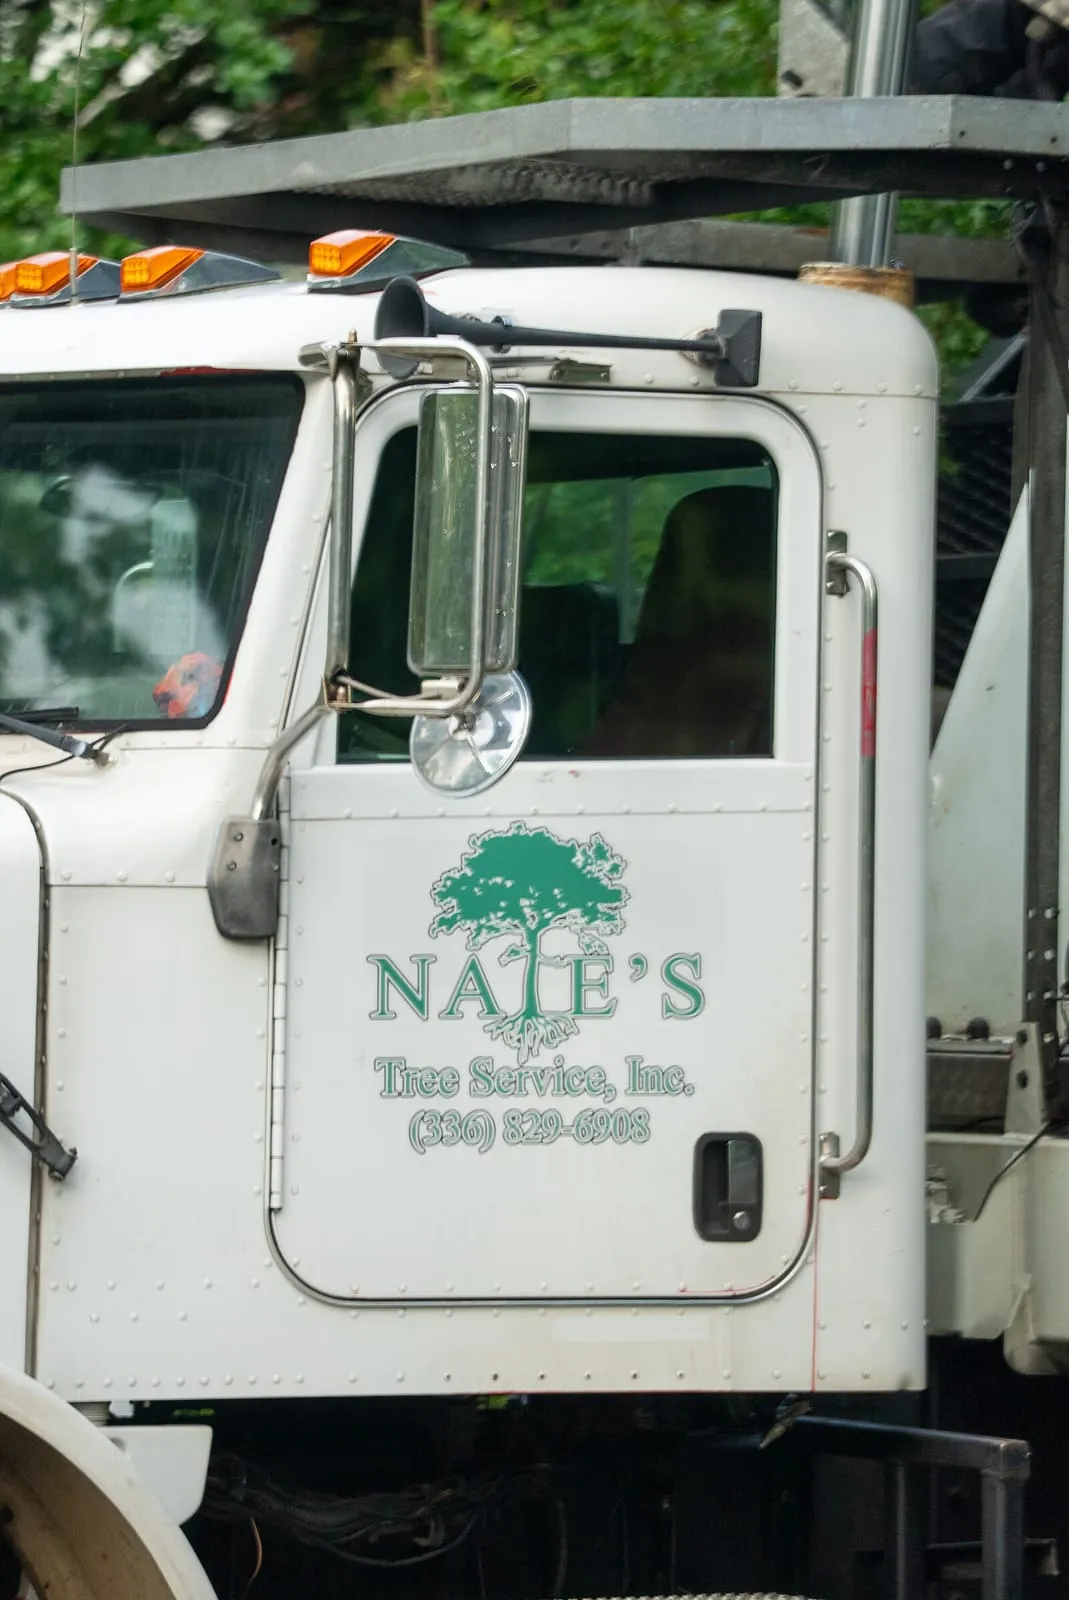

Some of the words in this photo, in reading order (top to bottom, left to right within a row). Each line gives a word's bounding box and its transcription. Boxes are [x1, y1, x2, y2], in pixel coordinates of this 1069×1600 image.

[374, 1056, 460, 1099] Tree
[469, 1055, 616, 1104] Service,
[625, 1055, 695, 1096] Inc.
[408, 1108, 496, 1154] (336)
[502, 1107, 651, 1145] 829-6908
